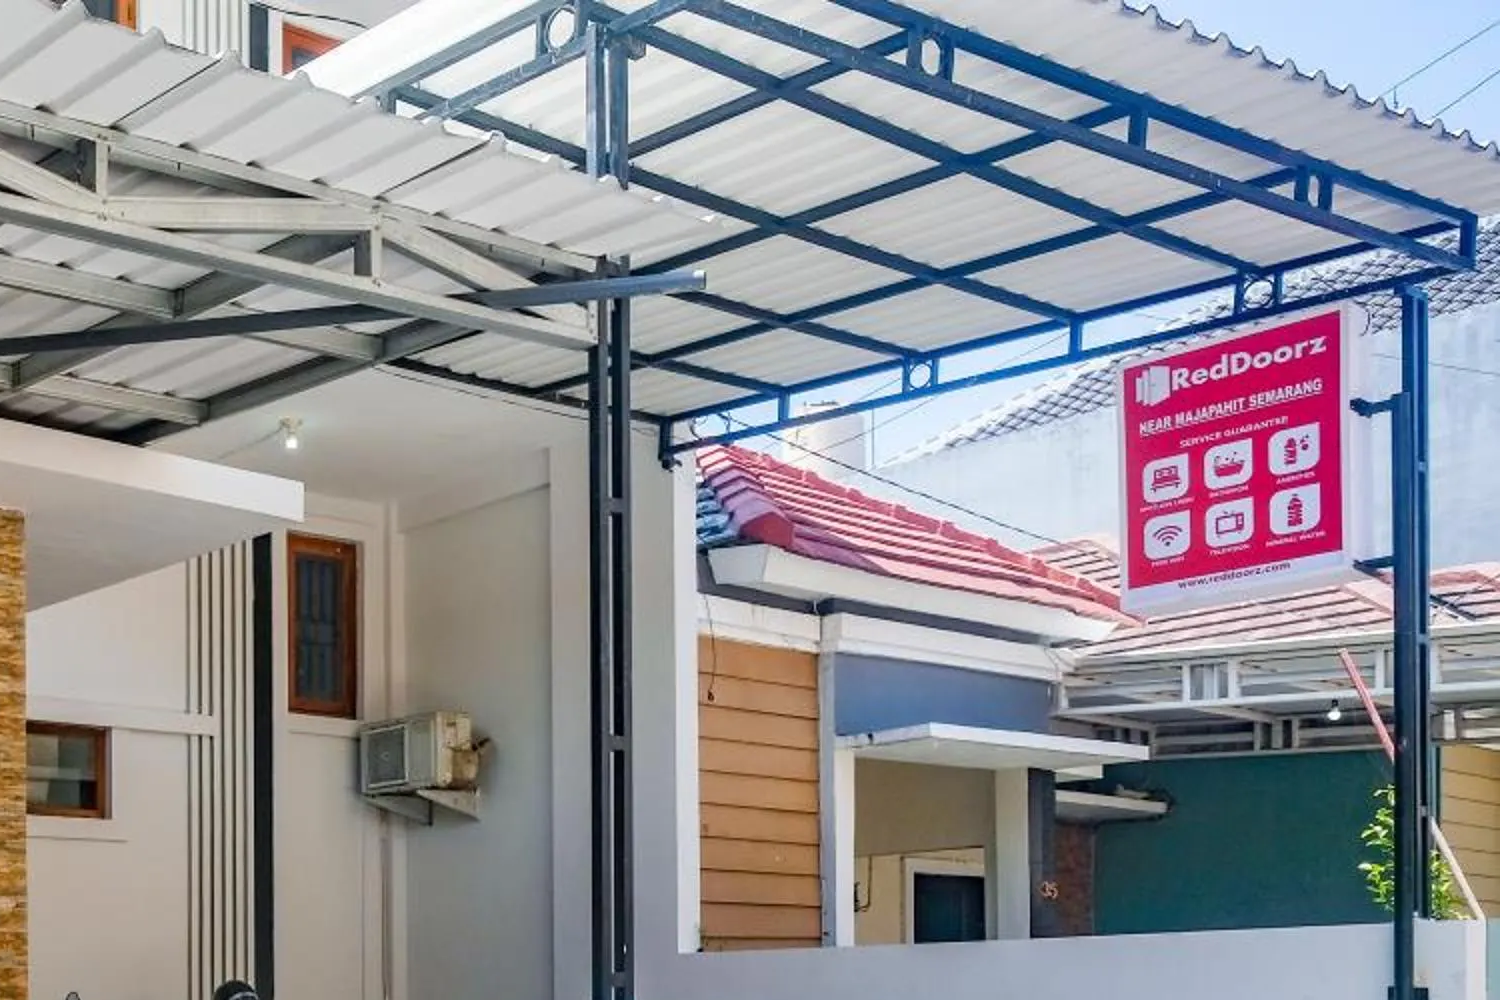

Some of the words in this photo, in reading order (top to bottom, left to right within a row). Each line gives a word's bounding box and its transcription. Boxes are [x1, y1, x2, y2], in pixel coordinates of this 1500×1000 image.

[1172, 336, 1327, 391] RedDoorz
[1139, 415, 1172, 435] NEAR
[1175, 398, 1246, 424] MAJAPAHIT
[1249, 378, 1323, 407] SEMARANG
[1177, 561, 1291, 589] www.reddoorz.com
